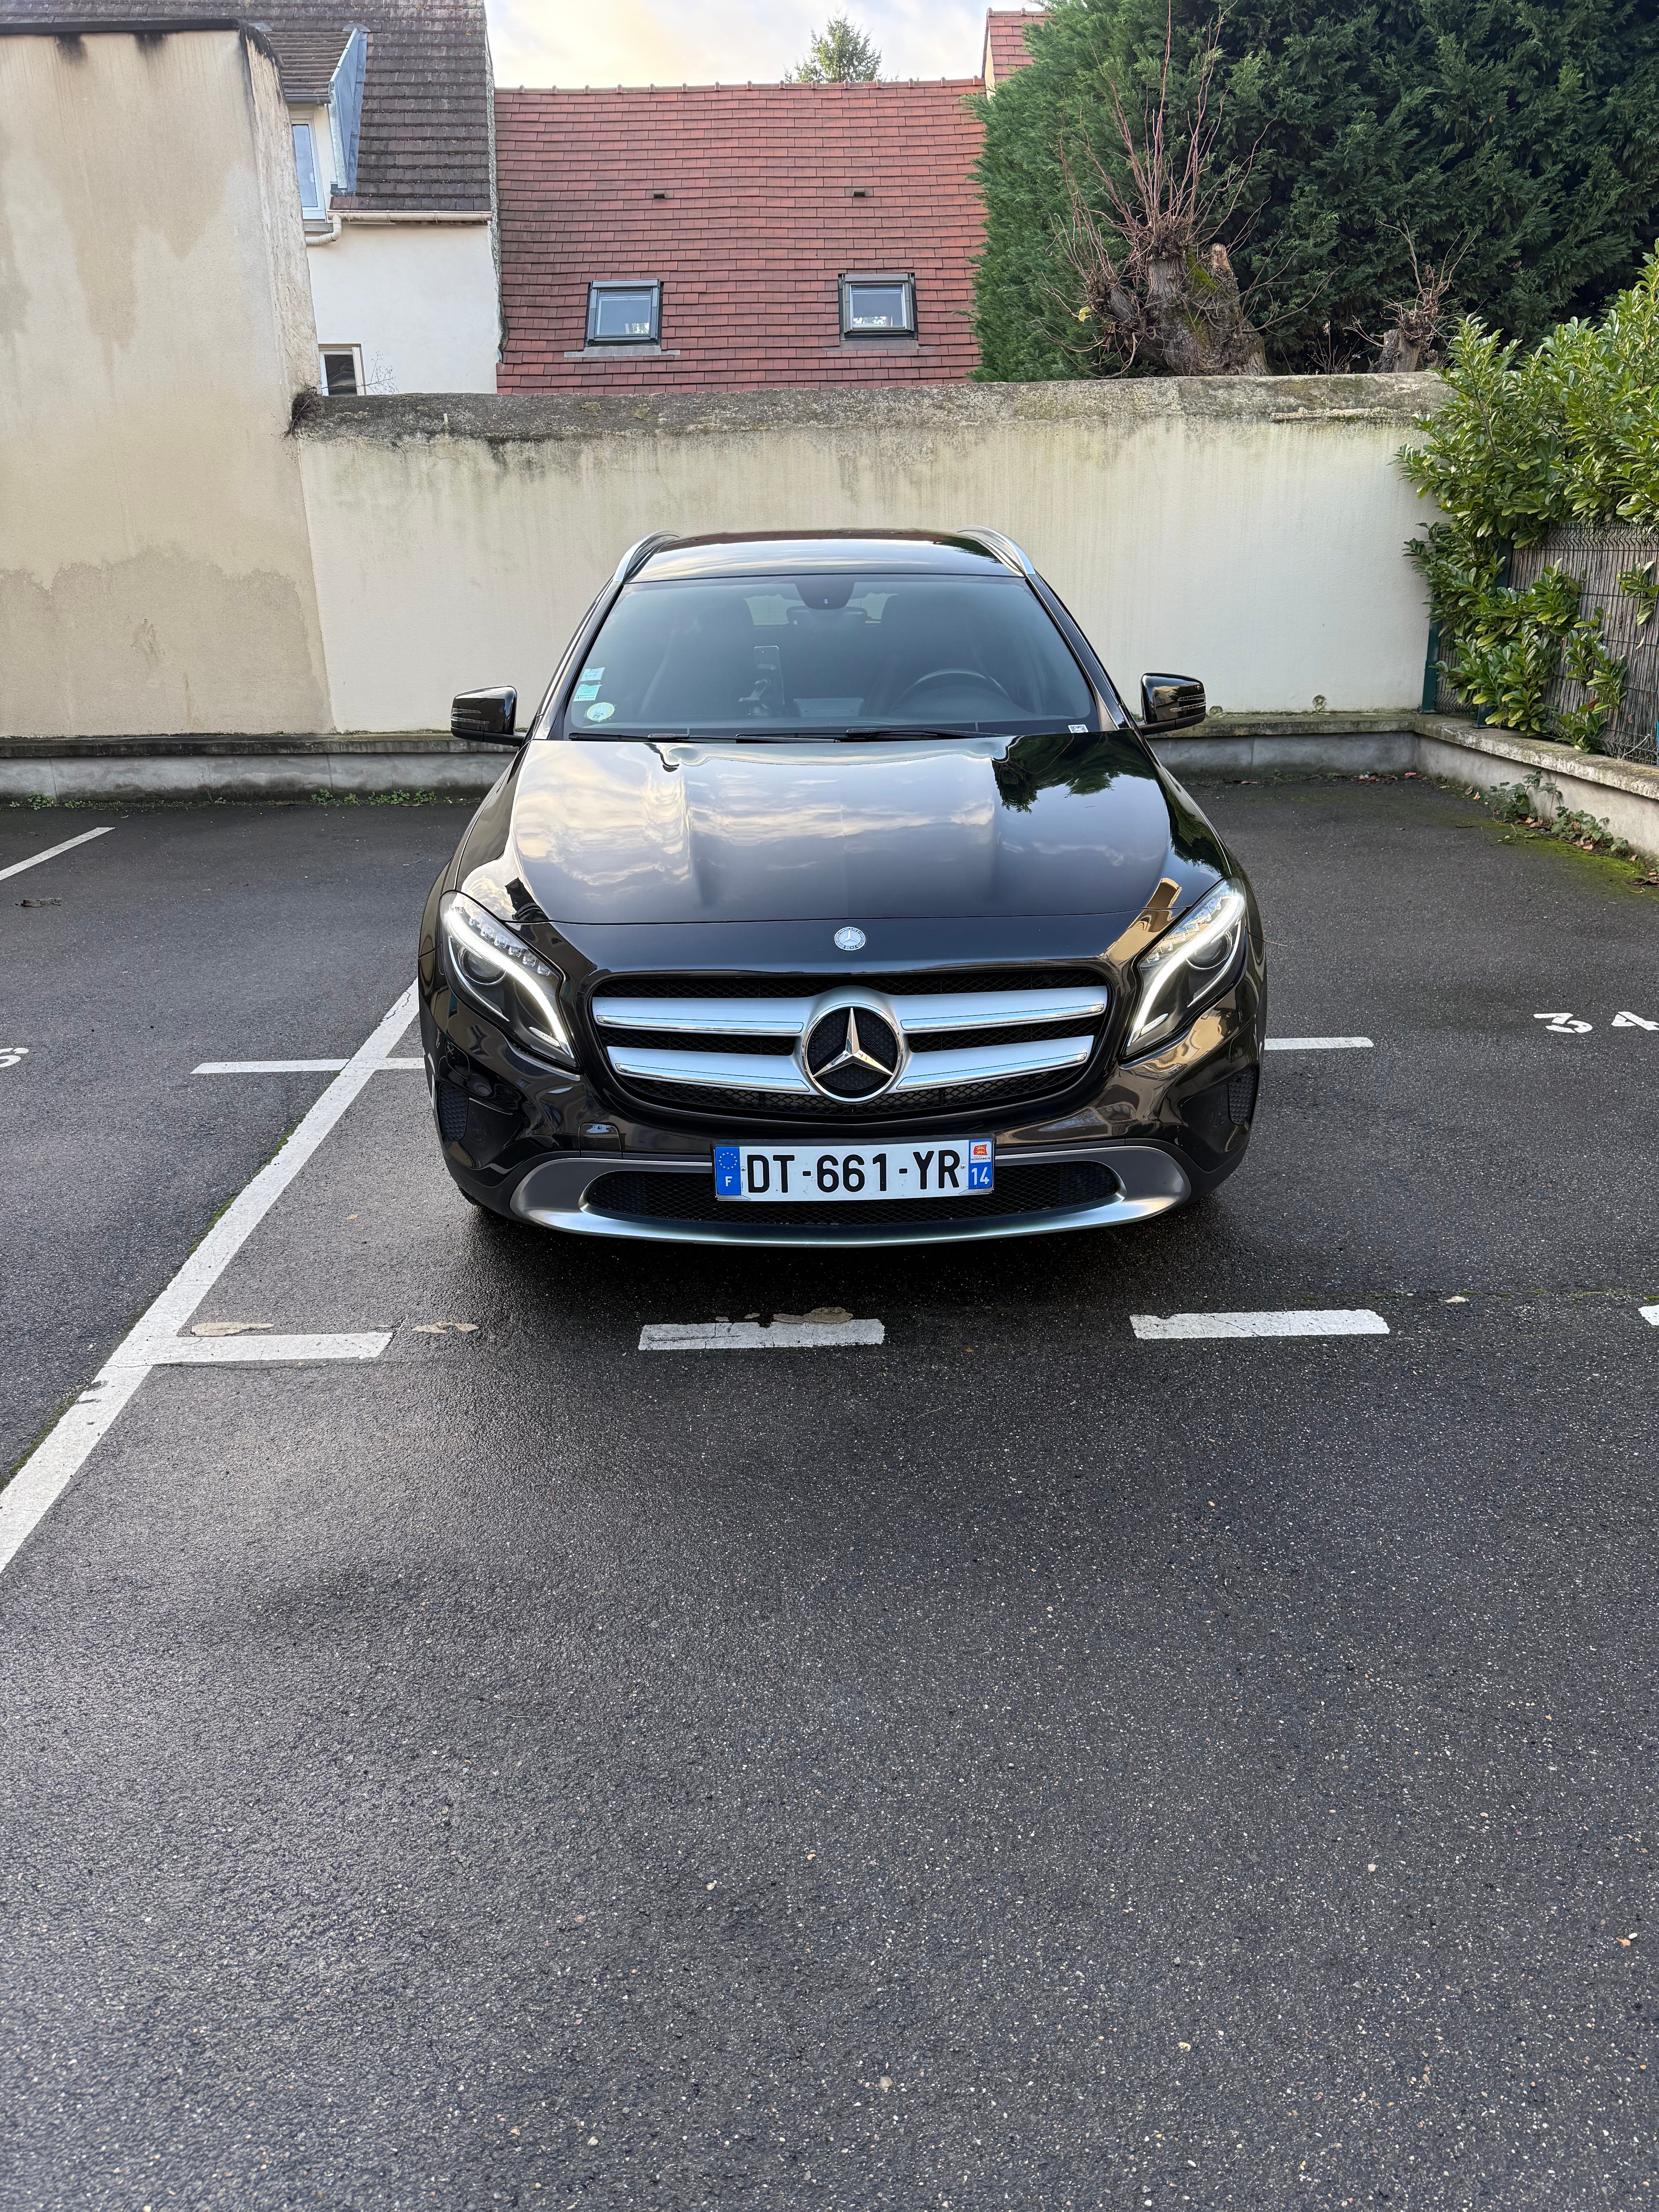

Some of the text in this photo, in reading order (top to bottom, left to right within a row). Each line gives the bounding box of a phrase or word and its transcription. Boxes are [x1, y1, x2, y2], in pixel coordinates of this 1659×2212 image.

[747, 1149, 960, 1193] DT-661-YR
[971, 1167, 990, 1185] 14
[725, 1176, 733, 1187] F
